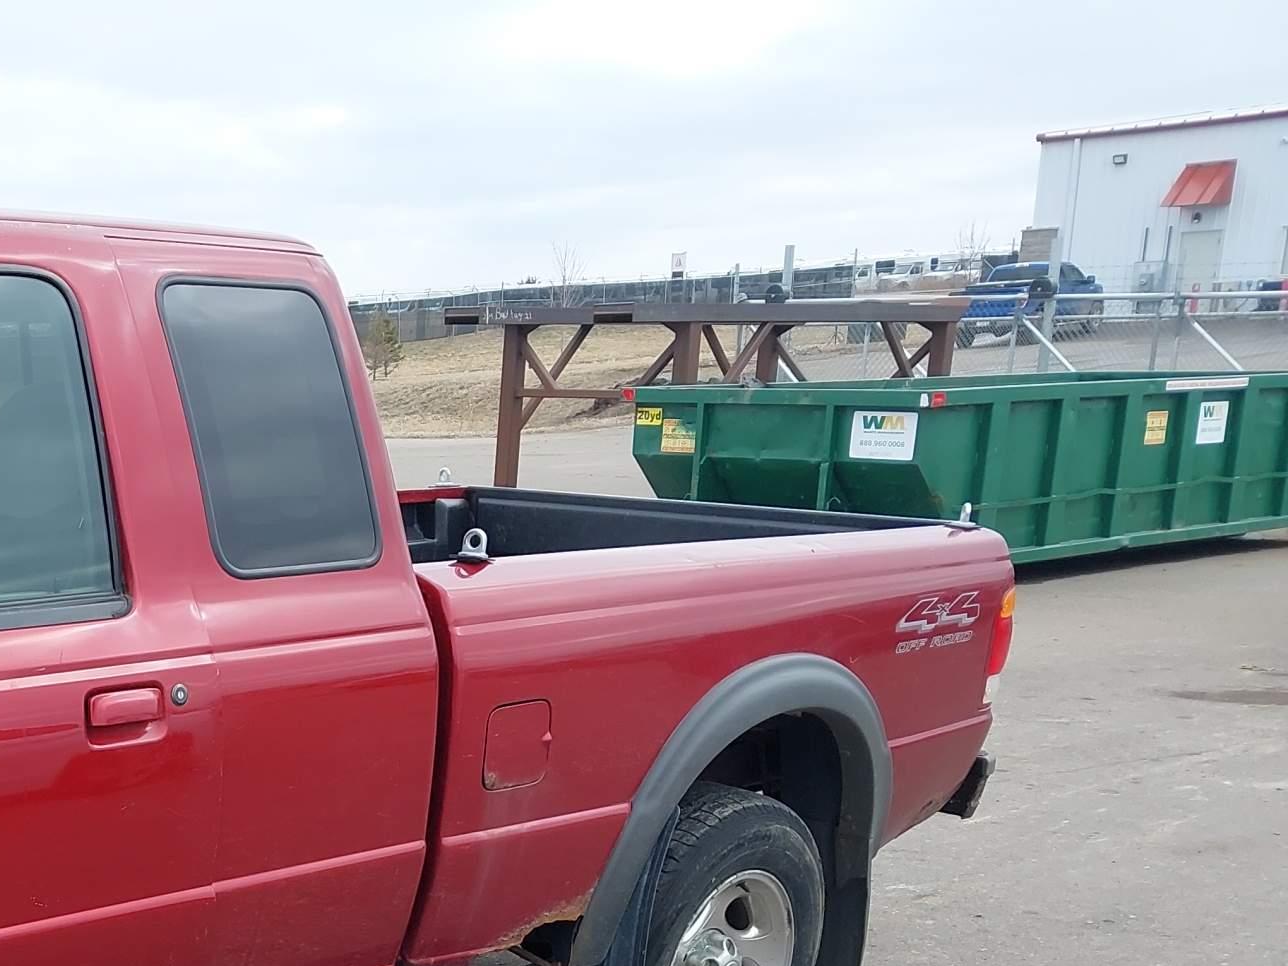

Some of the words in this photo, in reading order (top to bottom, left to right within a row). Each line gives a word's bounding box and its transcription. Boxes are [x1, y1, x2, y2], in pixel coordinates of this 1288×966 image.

[638, 410, 662, 423] 20yd
[862, 415, 905, 430] WM
[896, 591, 981, 634] 4x4
[896, 638, 928, 654] OFF
[929, 630, 973, 648] ROAD
